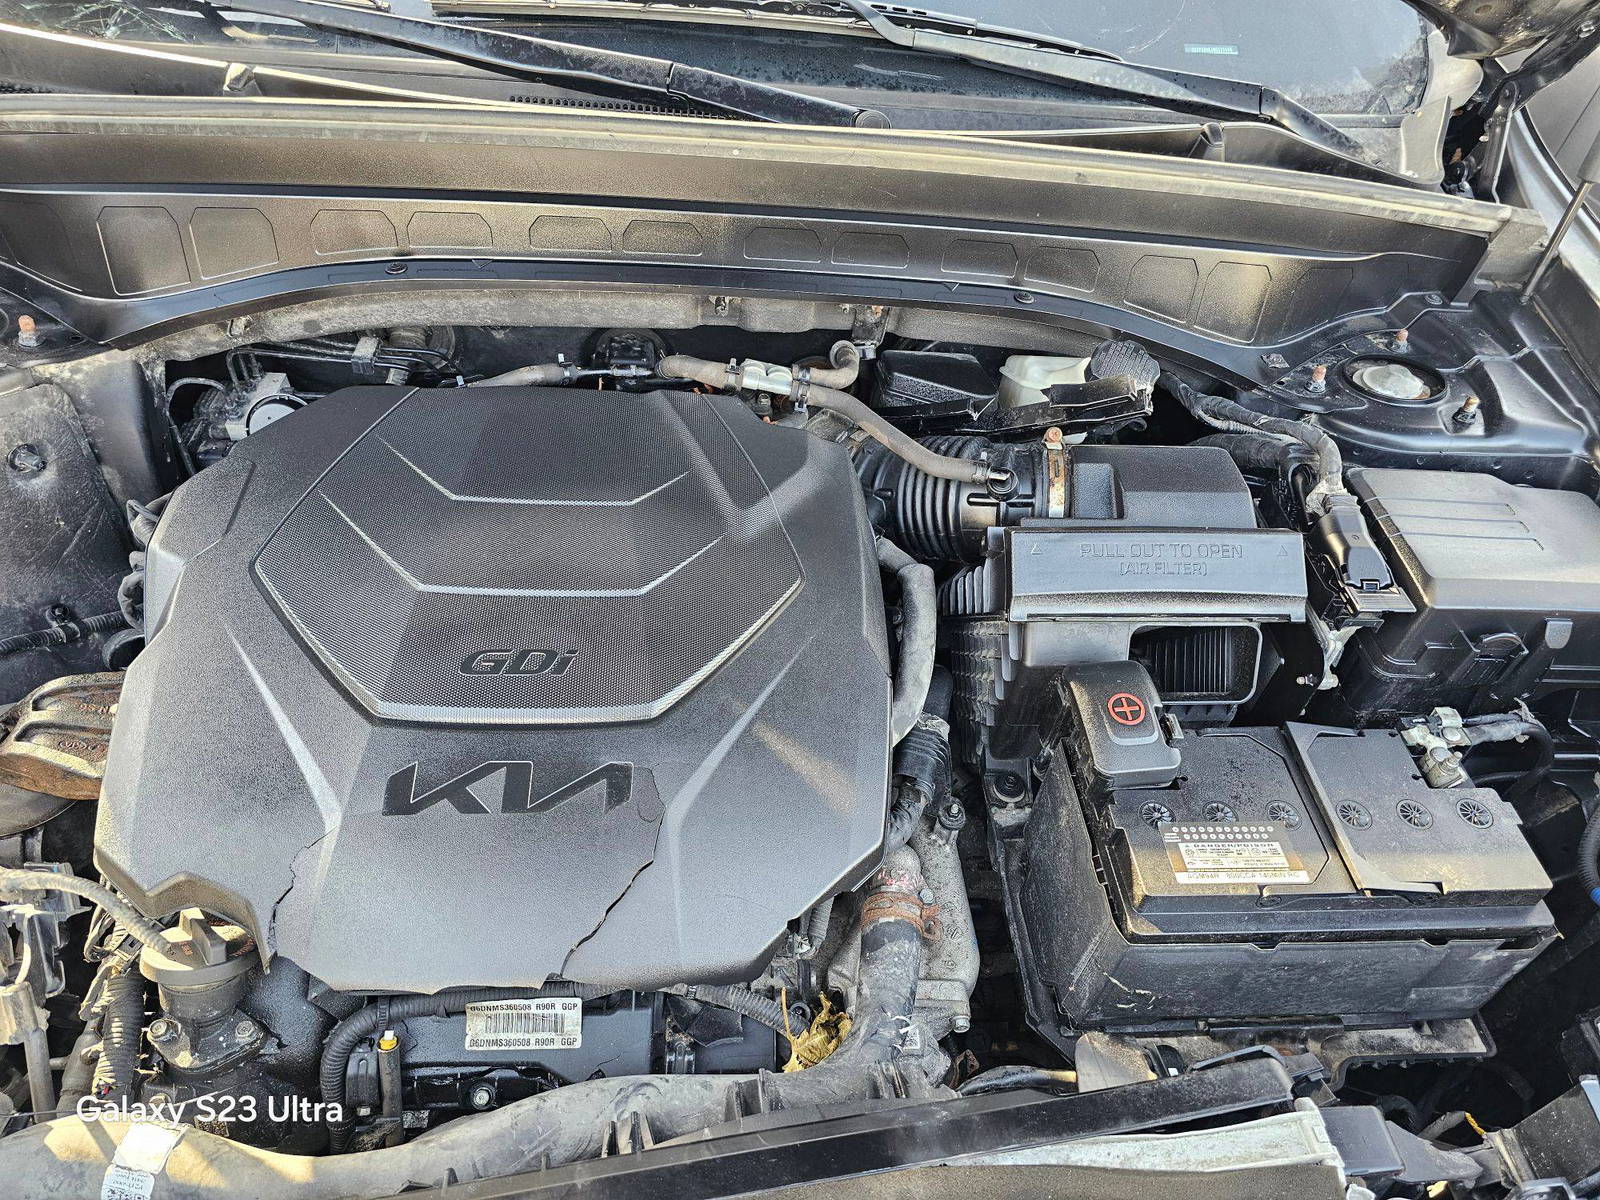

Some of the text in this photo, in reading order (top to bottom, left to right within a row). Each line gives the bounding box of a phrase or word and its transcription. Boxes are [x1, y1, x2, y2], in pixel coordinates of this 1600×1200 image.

[1080, 543, 1243, 559] PULL OUT TO OPEN
[459, 650, 579, 677] GDi
[535, 1003, 556, 1011] R90R
[561, 1003, 578, 1011] GGP
[469, 1038, 578, 1047] G6DNMS360508 R90R GGP
